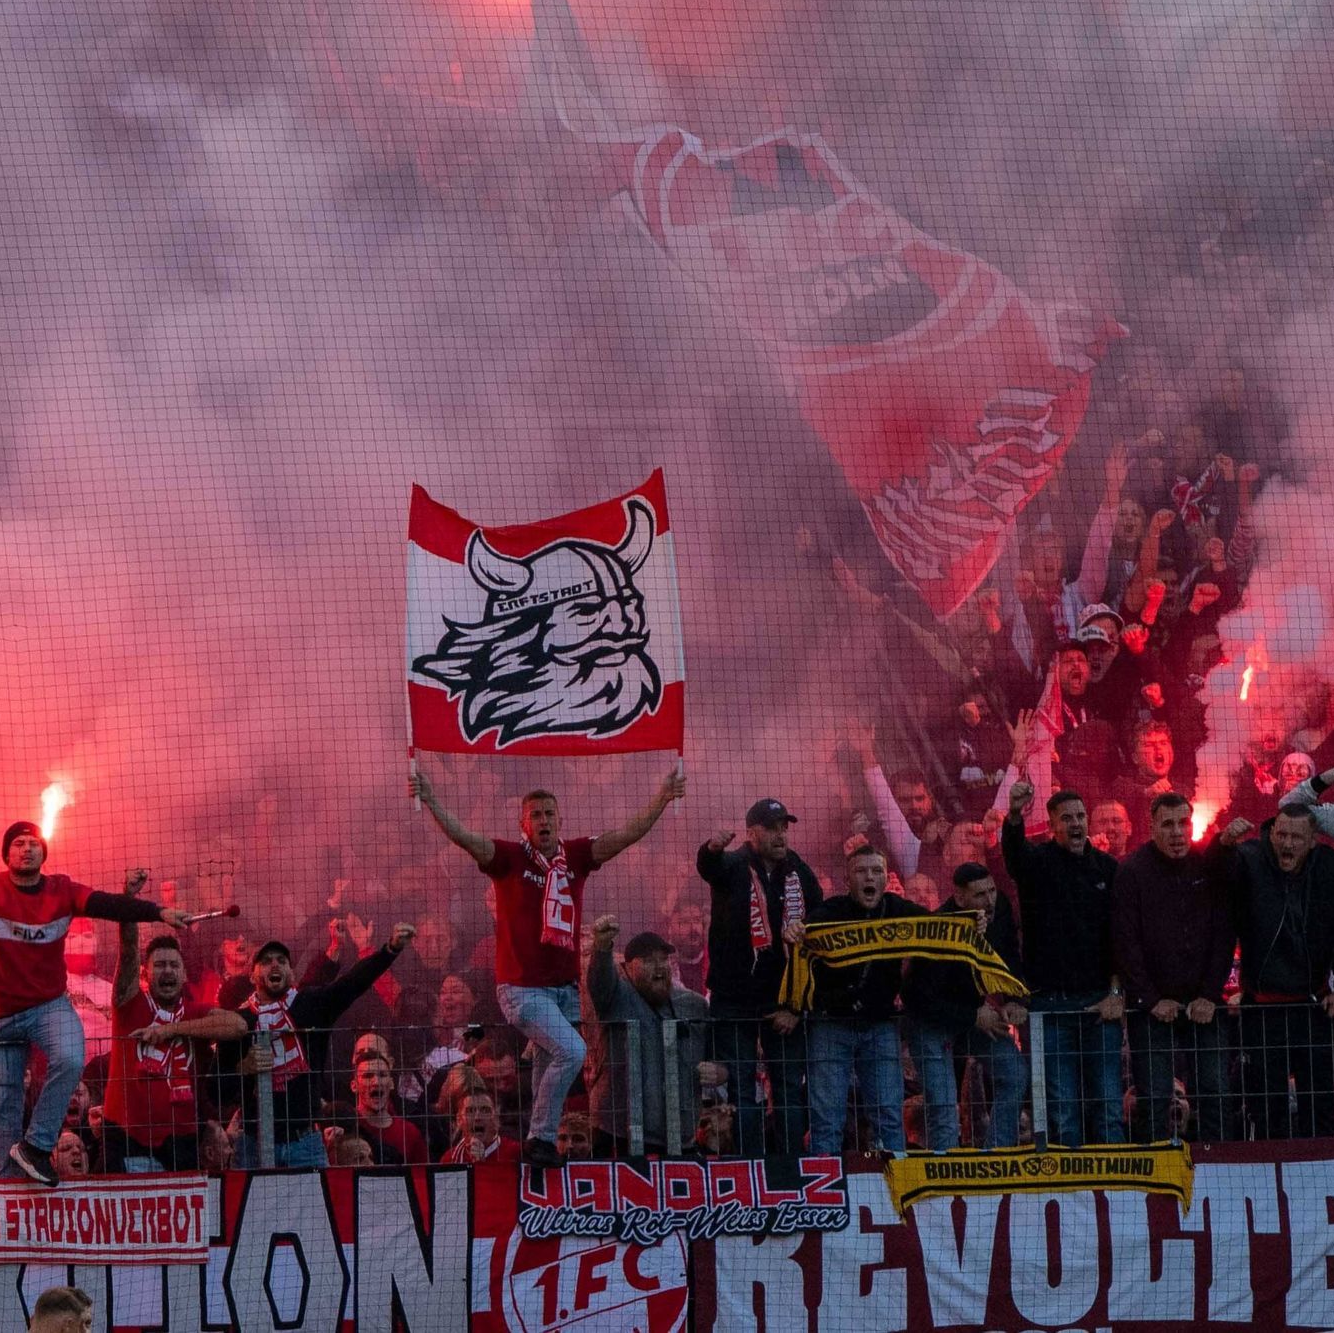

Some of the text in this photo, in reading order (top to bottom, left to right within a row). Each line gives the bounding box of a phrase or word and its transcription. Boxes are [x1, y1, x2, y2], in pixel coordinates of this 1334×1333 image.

[13, 926, 46, 940] FILA
[925, 1156, 1154, 1181] BORUSSIA DORTMUND
[6, 1194, 206, 1246] STADIONVERBOT
[519, 1206, 616, 1238] Ultras
[772, 1199, 850, 1234] Essen
